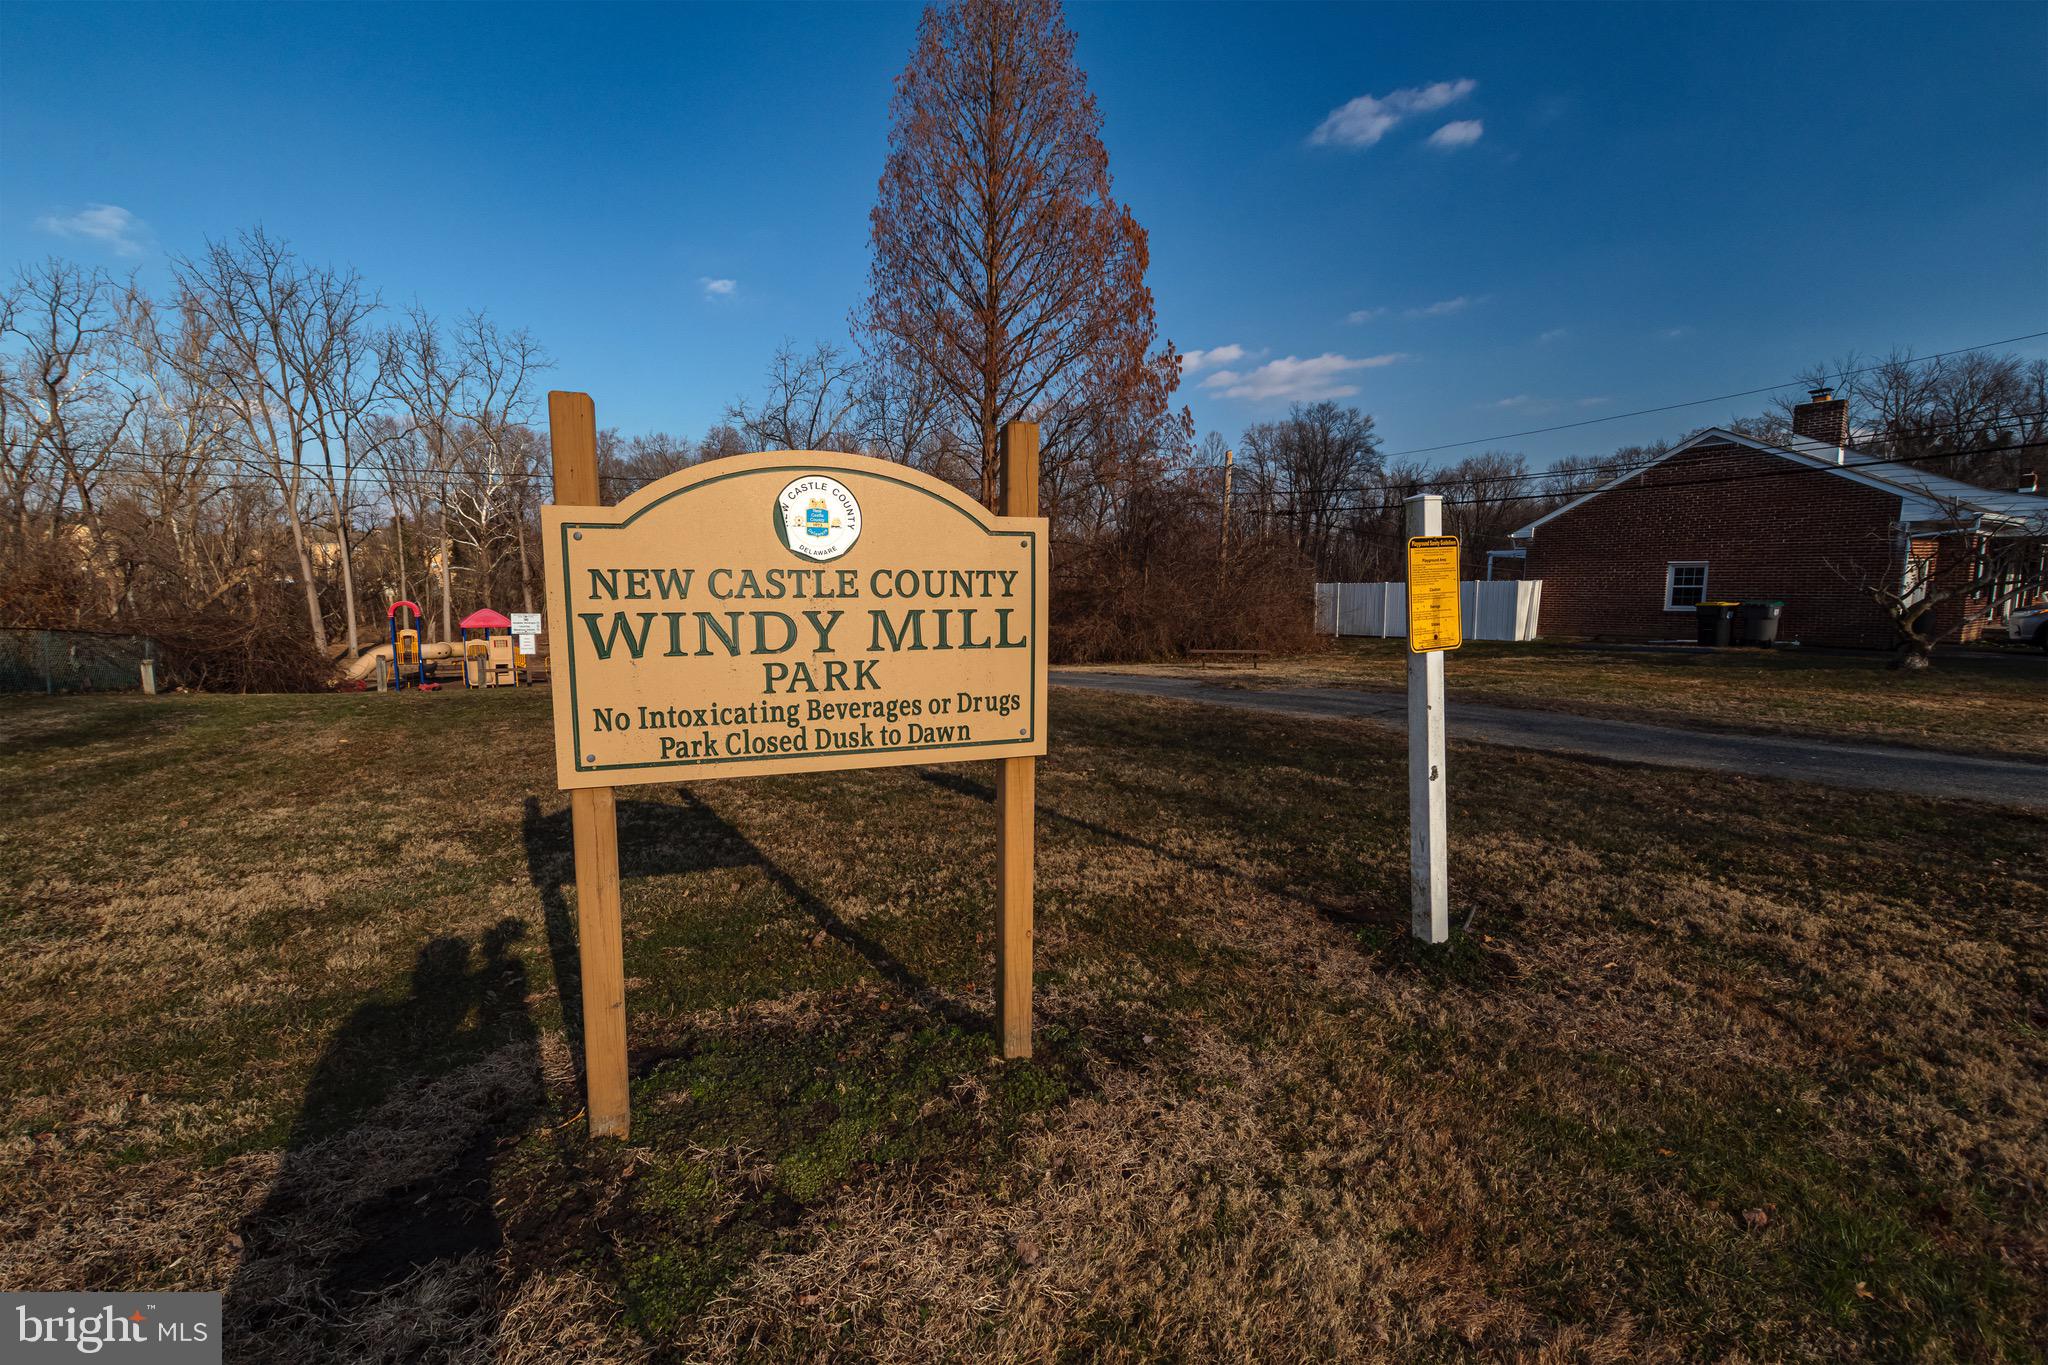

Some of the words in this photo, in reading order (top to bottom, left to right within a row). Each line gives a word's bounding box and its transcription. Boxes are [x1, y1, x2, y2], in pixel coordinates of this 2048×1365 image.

[788, 482, 828, 500] CASTLE
[832, 488, 856, 530] COUNTY
[799, 545, 838, 556] DELAWARE
[587, 569, 695, 600] NEW
[708, 569, 859, 600] CASTLE
[870, 569, 1018, 599] COUNTY
[578, 609, 845, 660] WINDY
[867, 608, 1027, 652] MILL
[763, 659, 881, 695] PARK
[593, 707, 630, 732] No
[638, 701, 800, 730] Intoxicating
[806, 698, 922, 721] Beverages
[928, 698, 951, 714] or
[957, 692, 1021, 717] Drugs
[660, 731, 719, 760] Park
[725, 725, 808, 756] Closed
[815, 723, 873, 750] Dusk
[880, 725, 901, 746] to
[908, 723, 971, 745] Dawn
